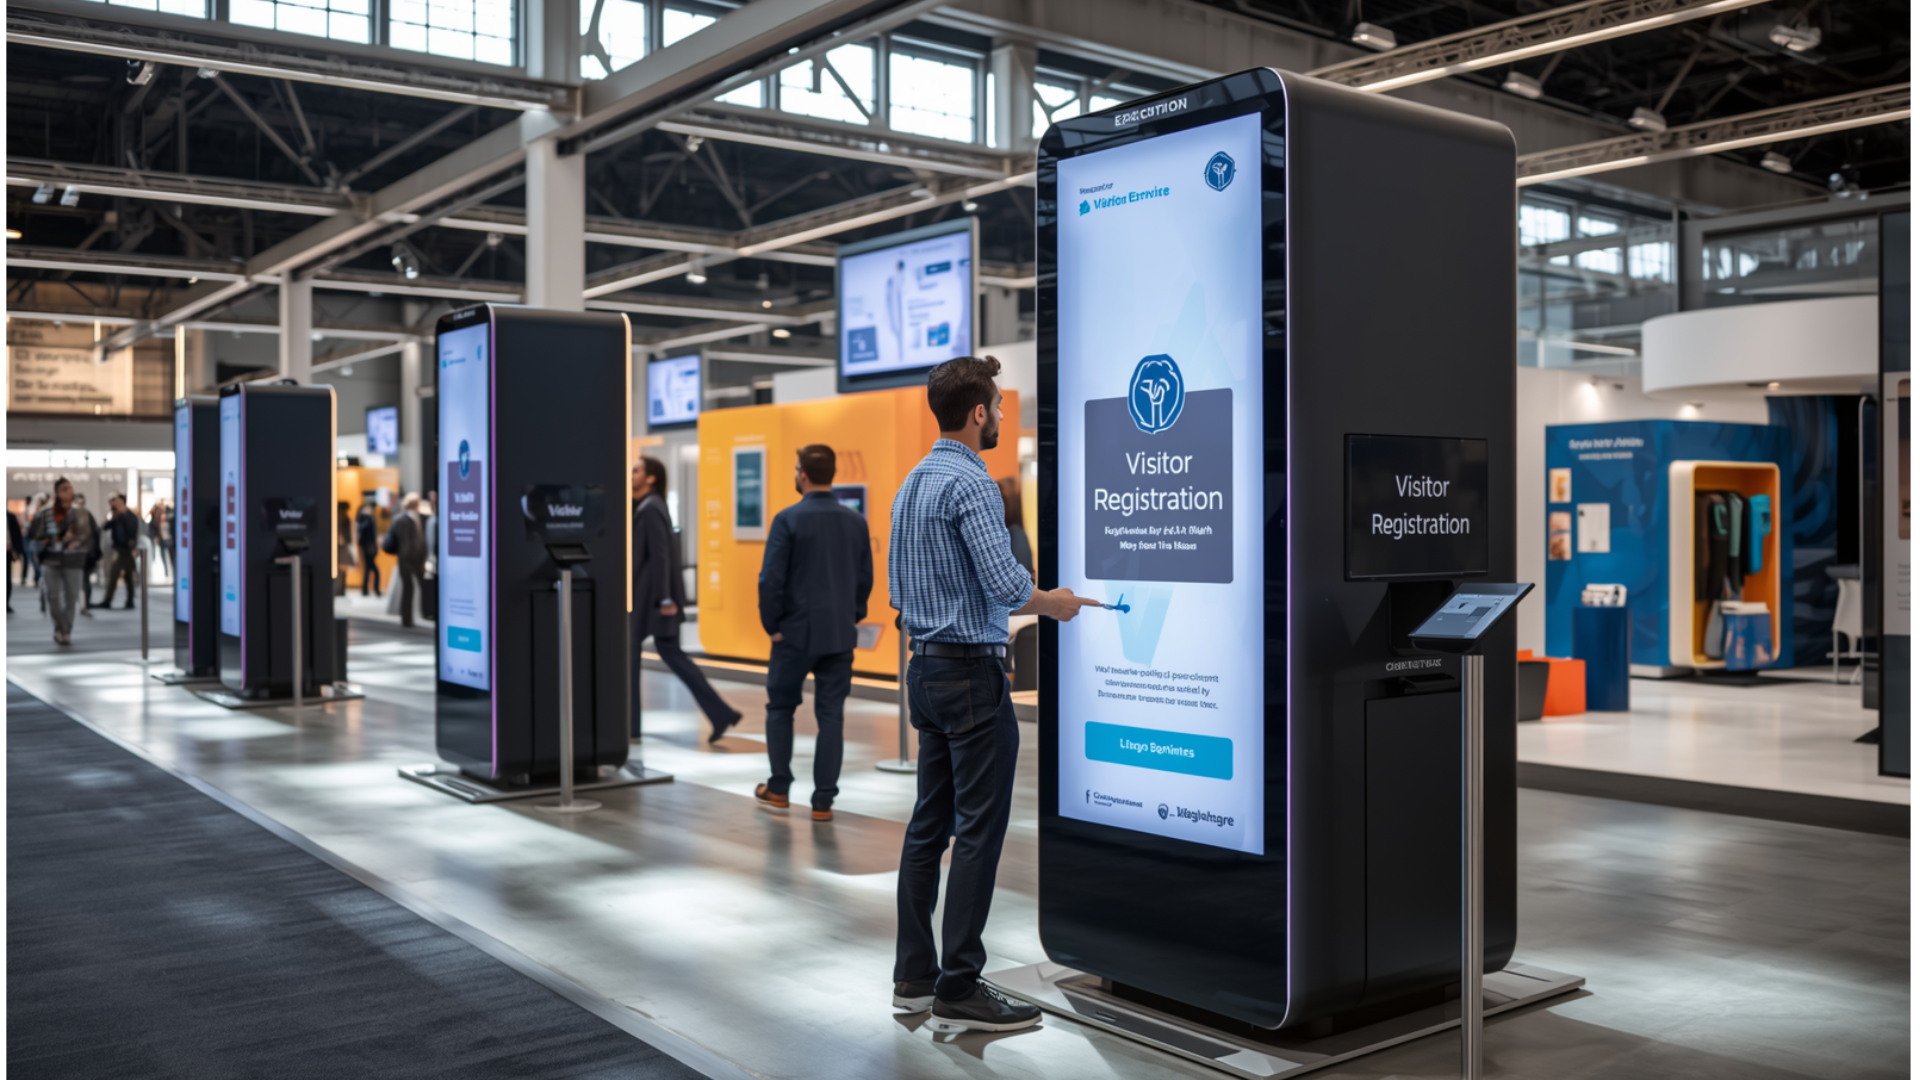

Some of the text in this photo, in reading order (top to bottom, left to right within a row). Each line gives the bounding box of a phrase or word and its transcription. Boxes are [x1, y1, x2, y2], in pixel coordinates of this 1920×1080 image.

[1125, 451, 1193, 475] Visitor
[1395, 475, 1450, 497] Visitor
[1094, 486, 1223, 517] Registration
[1372, 513, 1470, 540] Registration
